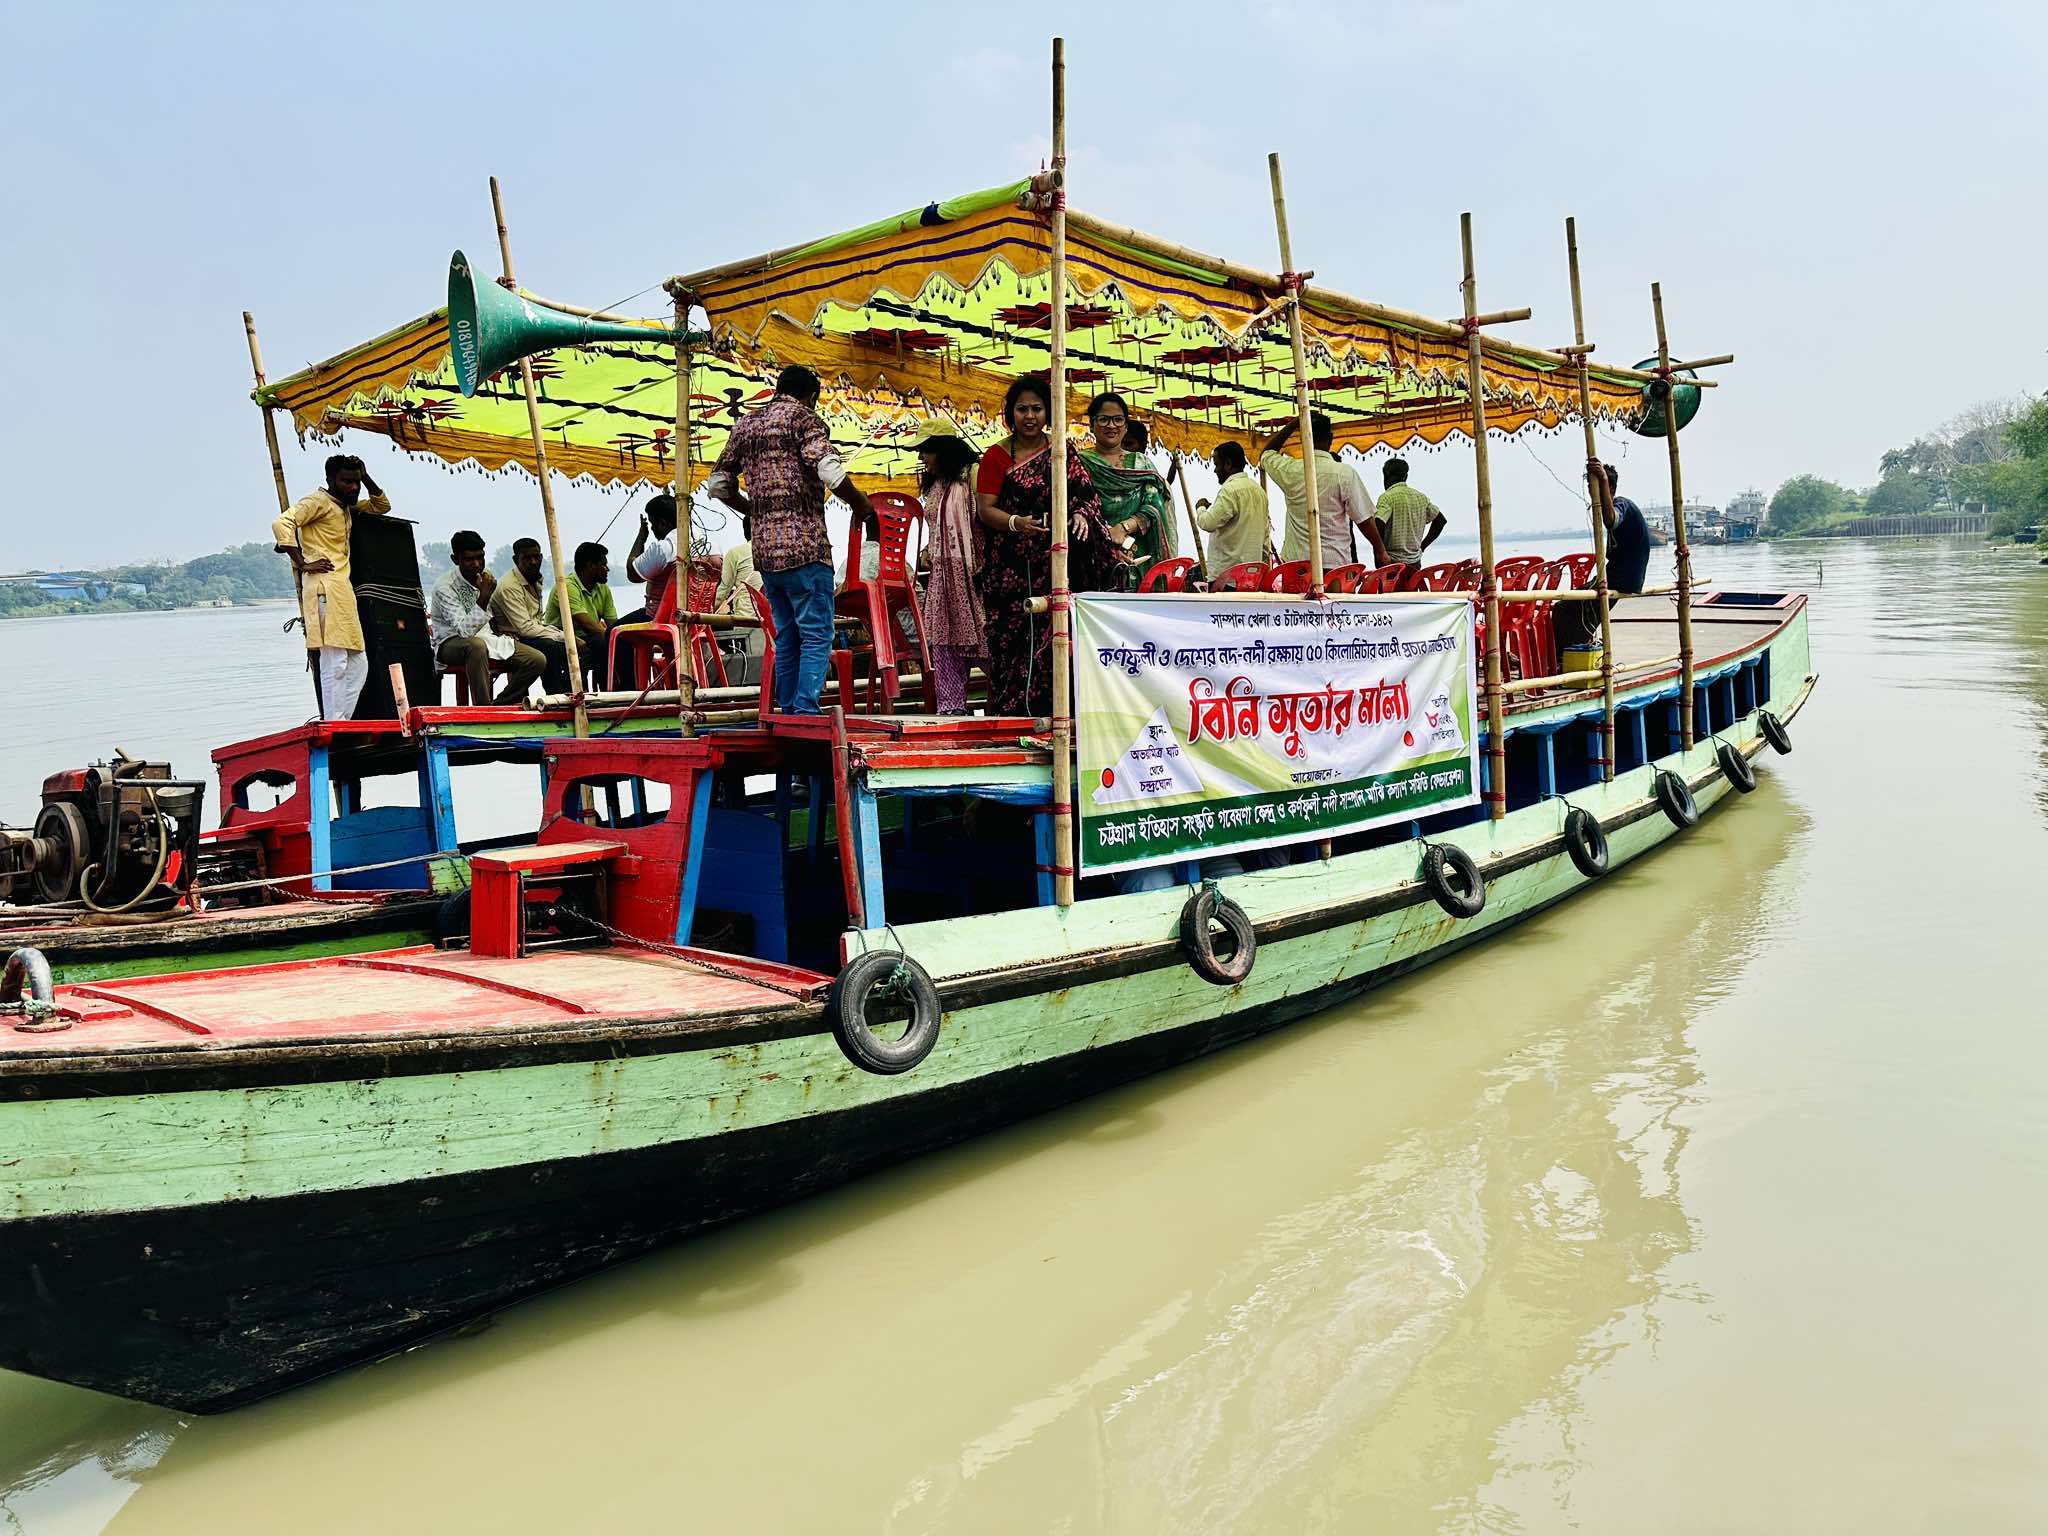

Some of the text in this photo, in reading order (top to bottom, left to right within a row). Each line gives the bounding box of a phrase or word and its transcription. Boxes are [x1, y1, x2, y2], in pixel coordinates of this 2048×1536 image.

[1210, 613, 1245, 629] সাম্পান
[1248, 612, 1270, 628] খেলা
[1273, 614, 1281, 627] ও
[1098, 641, 1157, 675] কর্ণফুলী
[1159, 649, 1170, 667] ও
[1174, 647, 1216, 668] দেশের
[1218, 640, 1265, 665] নদ-নদী
[1306, 645, 1322, 662] ৫০
[1325, 638, 1376, 661] কিলোমিটার
[1377, 637, 1401, 659] ব্যাপী
[1188, 676, 1410, 757] বিনি সুতার মালা
[1165, 744, 1180, 758] ঘাট
[1290, 768, 1333, 785] আয়োজনে
[1098, 819, 1136, 847] চট্টগ্রাম
[1138, 814, 1180, 843] ইতিহাস
[1182, 806, 1215, 841] সংস্কৃতি
[1219, 805, 1252, 829] গবেষণা
[1254, 803, 1277, 826] কেন্দ্র
[1277, 805, 1286, 819] ও
[1287, 792, 1320, 823] কর্ণফুলী
[1321, 788, 1338, 812] নদী
